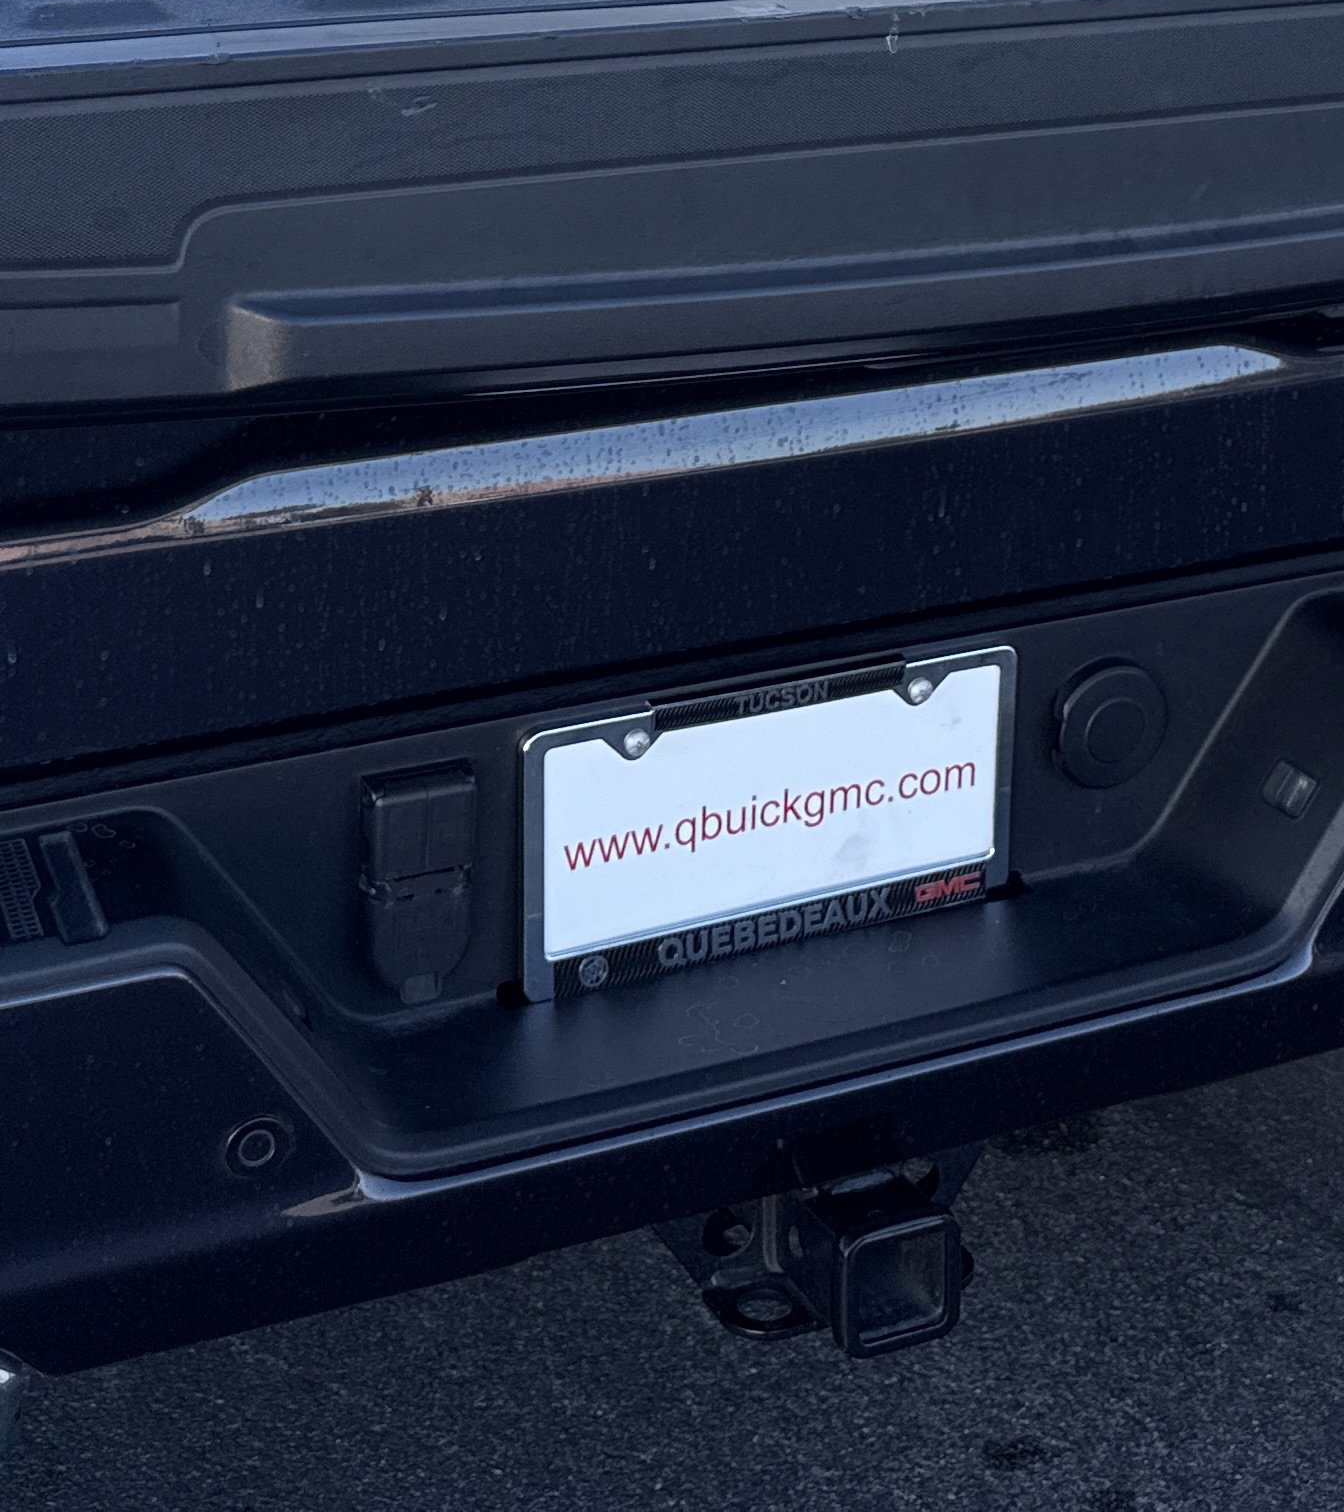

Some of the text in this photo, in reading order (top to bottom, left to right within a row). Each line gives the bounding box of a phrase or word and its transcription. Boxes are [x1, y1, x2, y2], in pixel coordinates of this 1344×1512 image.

[735, 680, 830, 716] TUCSON
[563, 761, 977, 871] www.qbuickgmc.com
[657, 872, 982, 969] QUEBEDEAUX GMC
